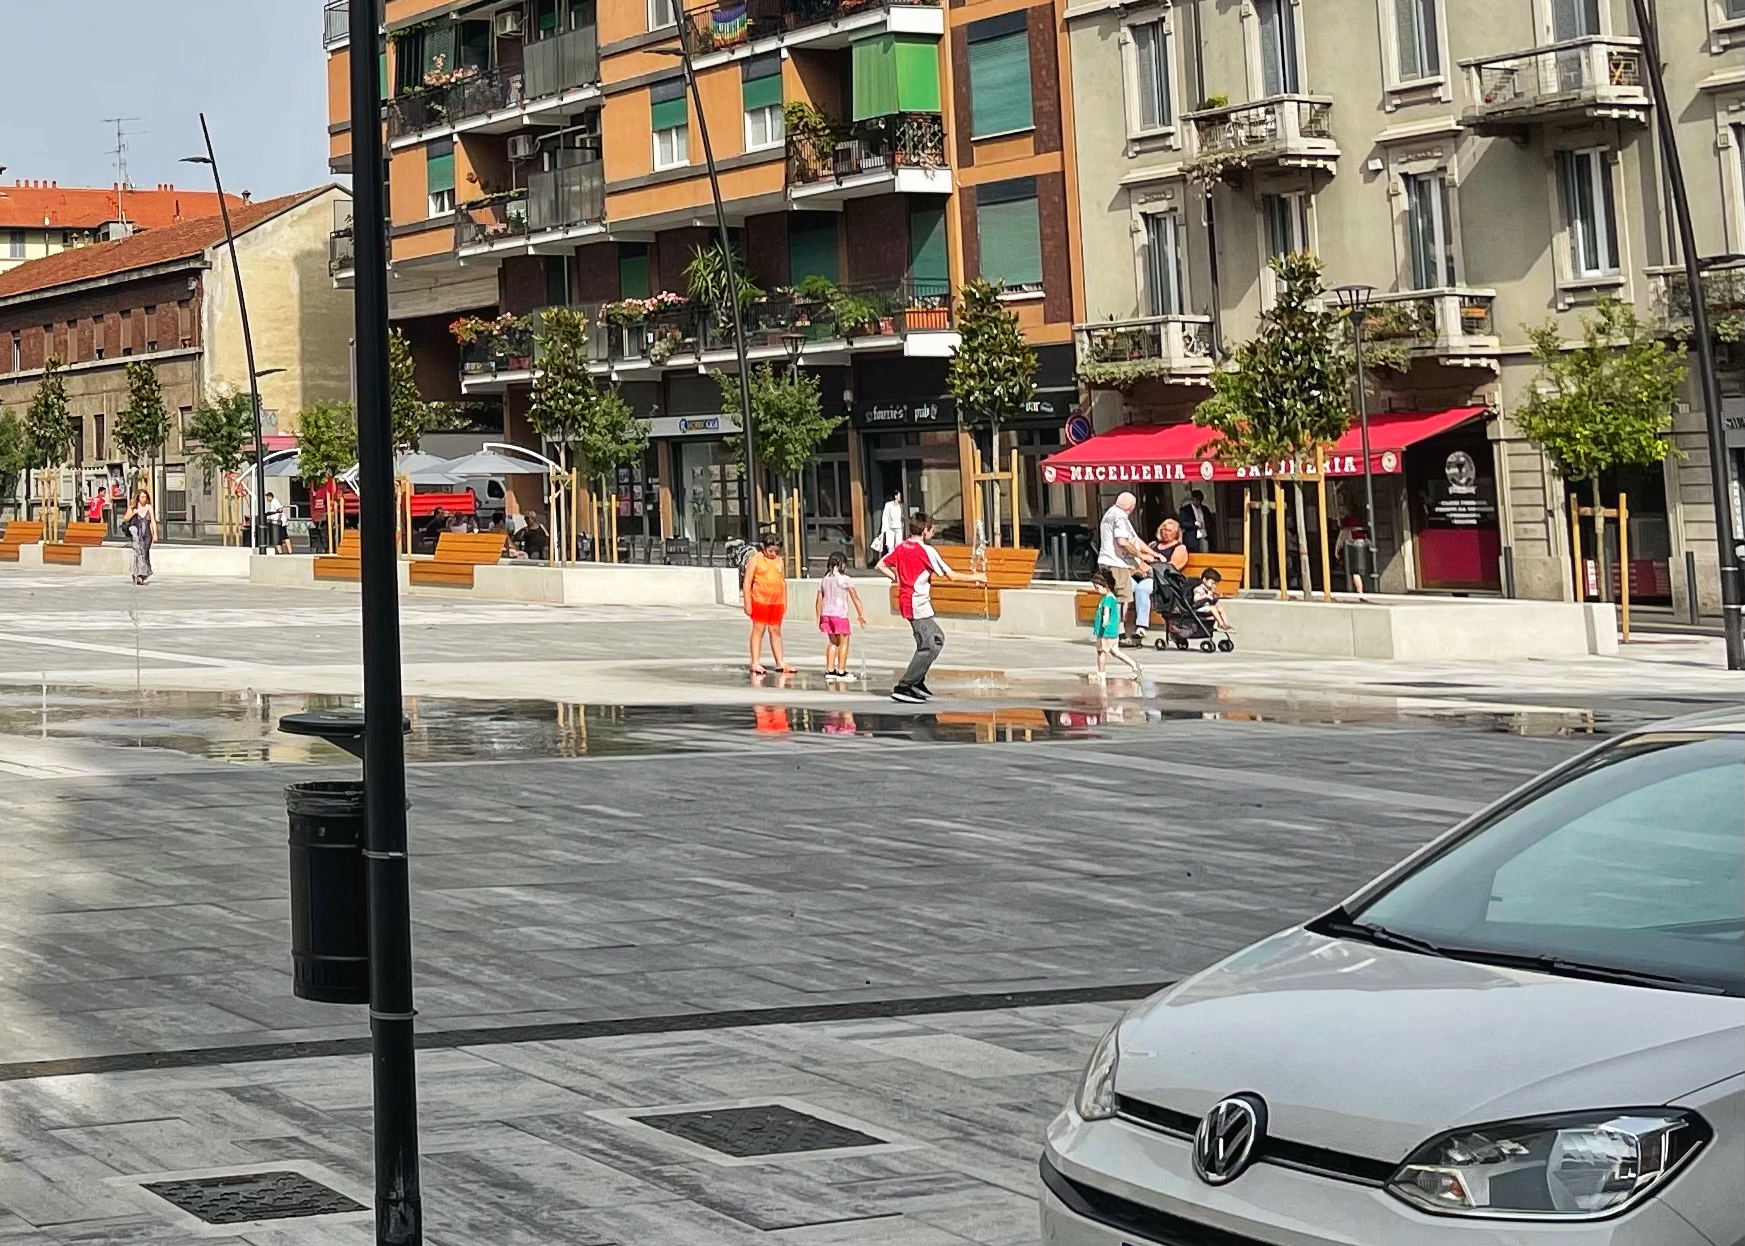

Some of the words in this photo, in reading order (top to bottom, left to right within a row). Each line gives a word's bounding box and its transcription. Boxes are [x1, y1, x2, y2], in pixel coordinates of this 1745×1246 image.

[914, 403, 930, 422] pub
[1724, 416, 1745, 430] SW
[1070, 463, 1186, 481] MACELLERIA
